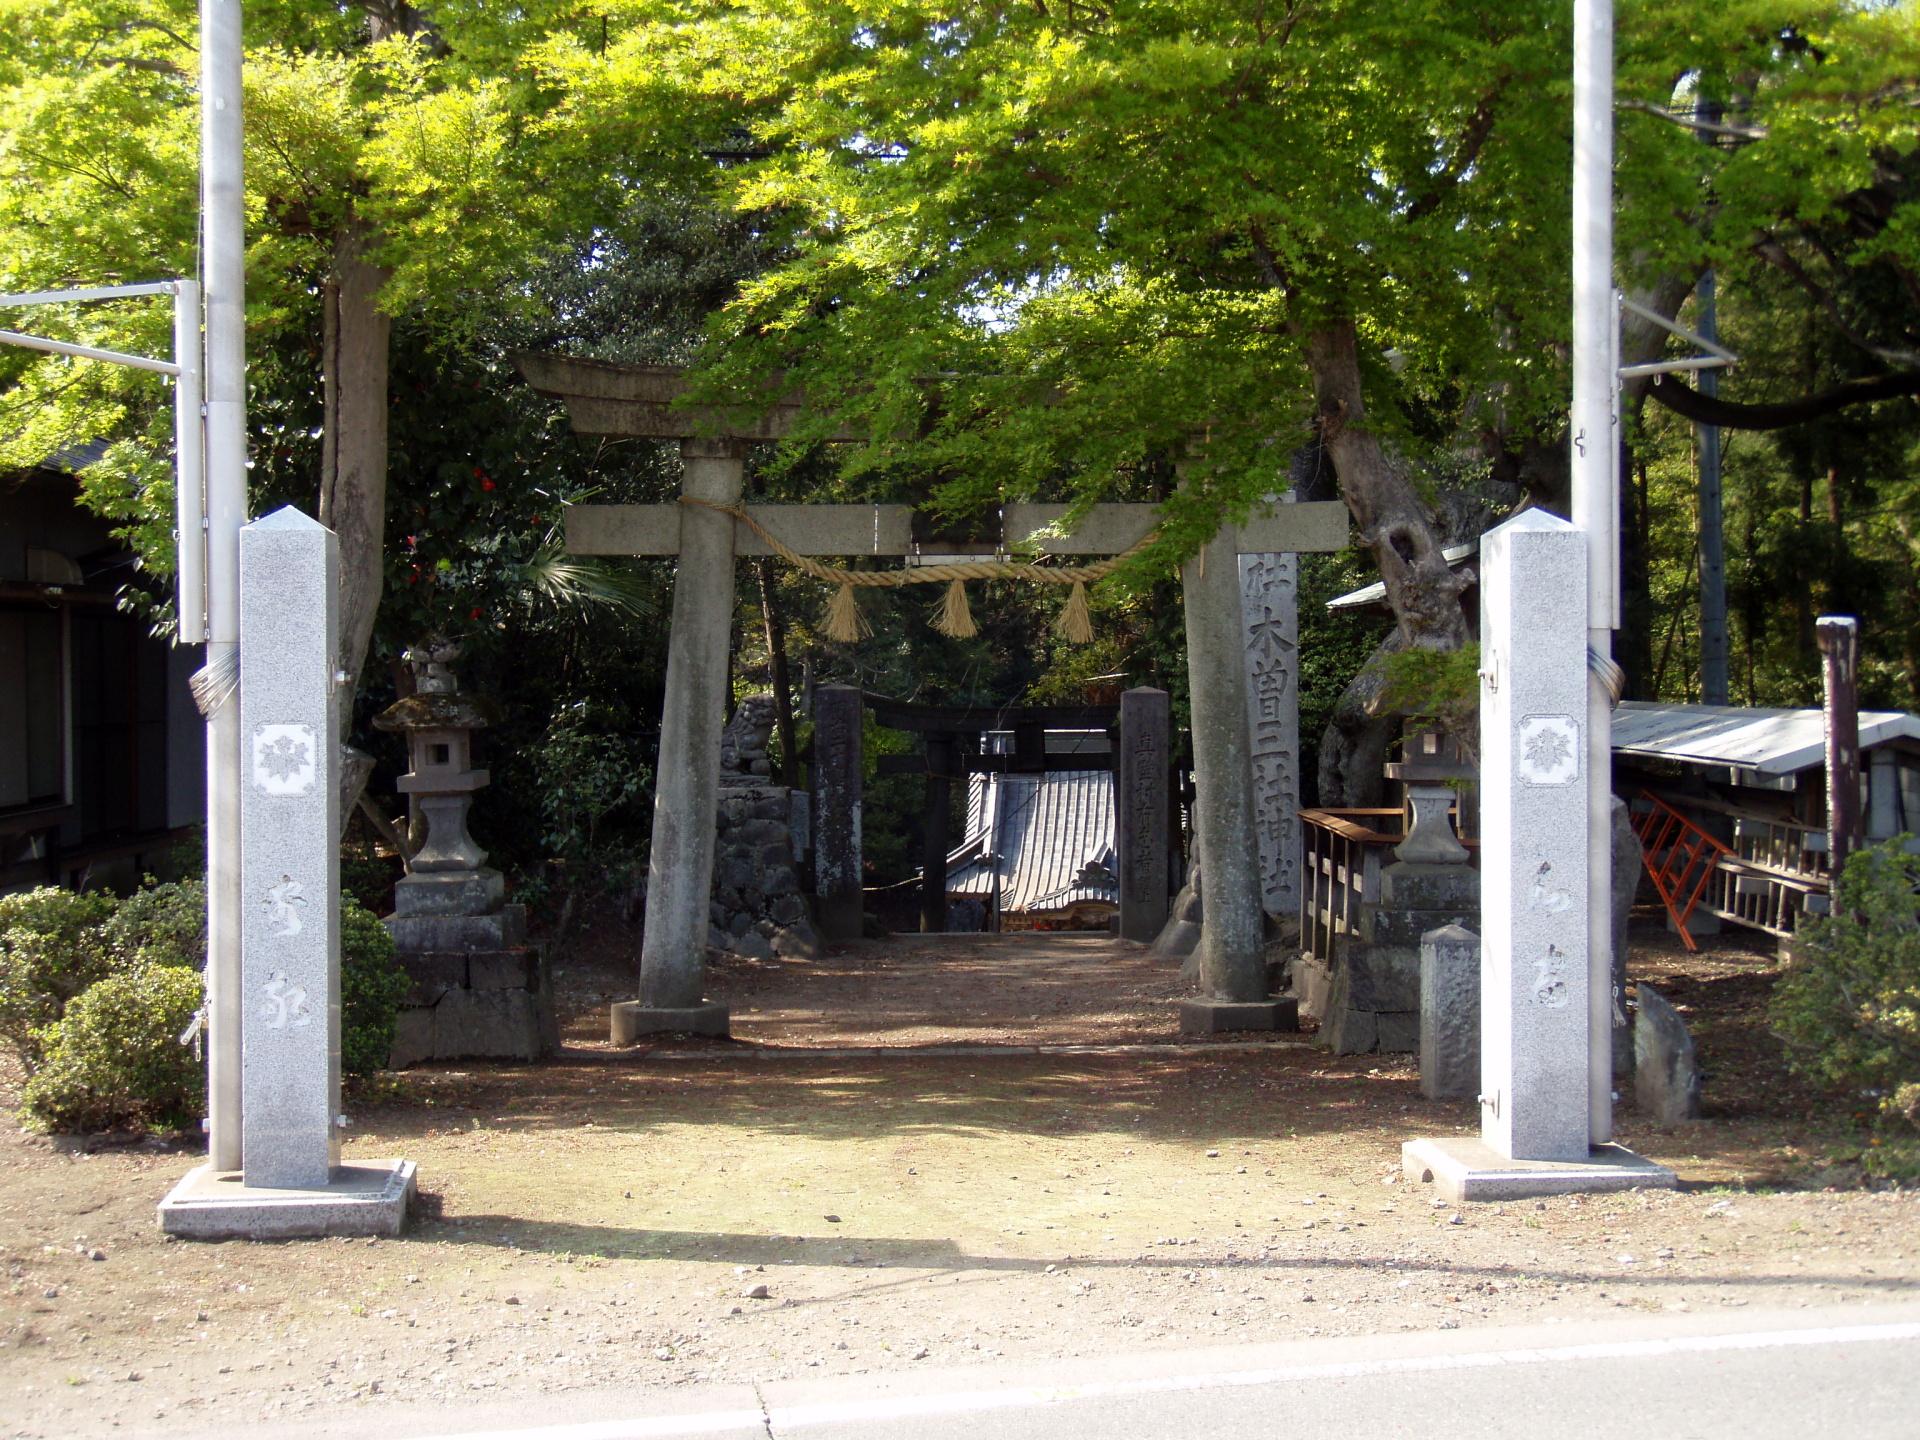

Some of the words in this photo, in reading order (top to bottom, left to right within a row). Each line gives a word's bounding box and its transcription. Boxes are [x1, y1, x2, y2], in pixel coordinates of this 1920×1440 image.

[1247, 495, 1296, 895] 社木曽三社神社
